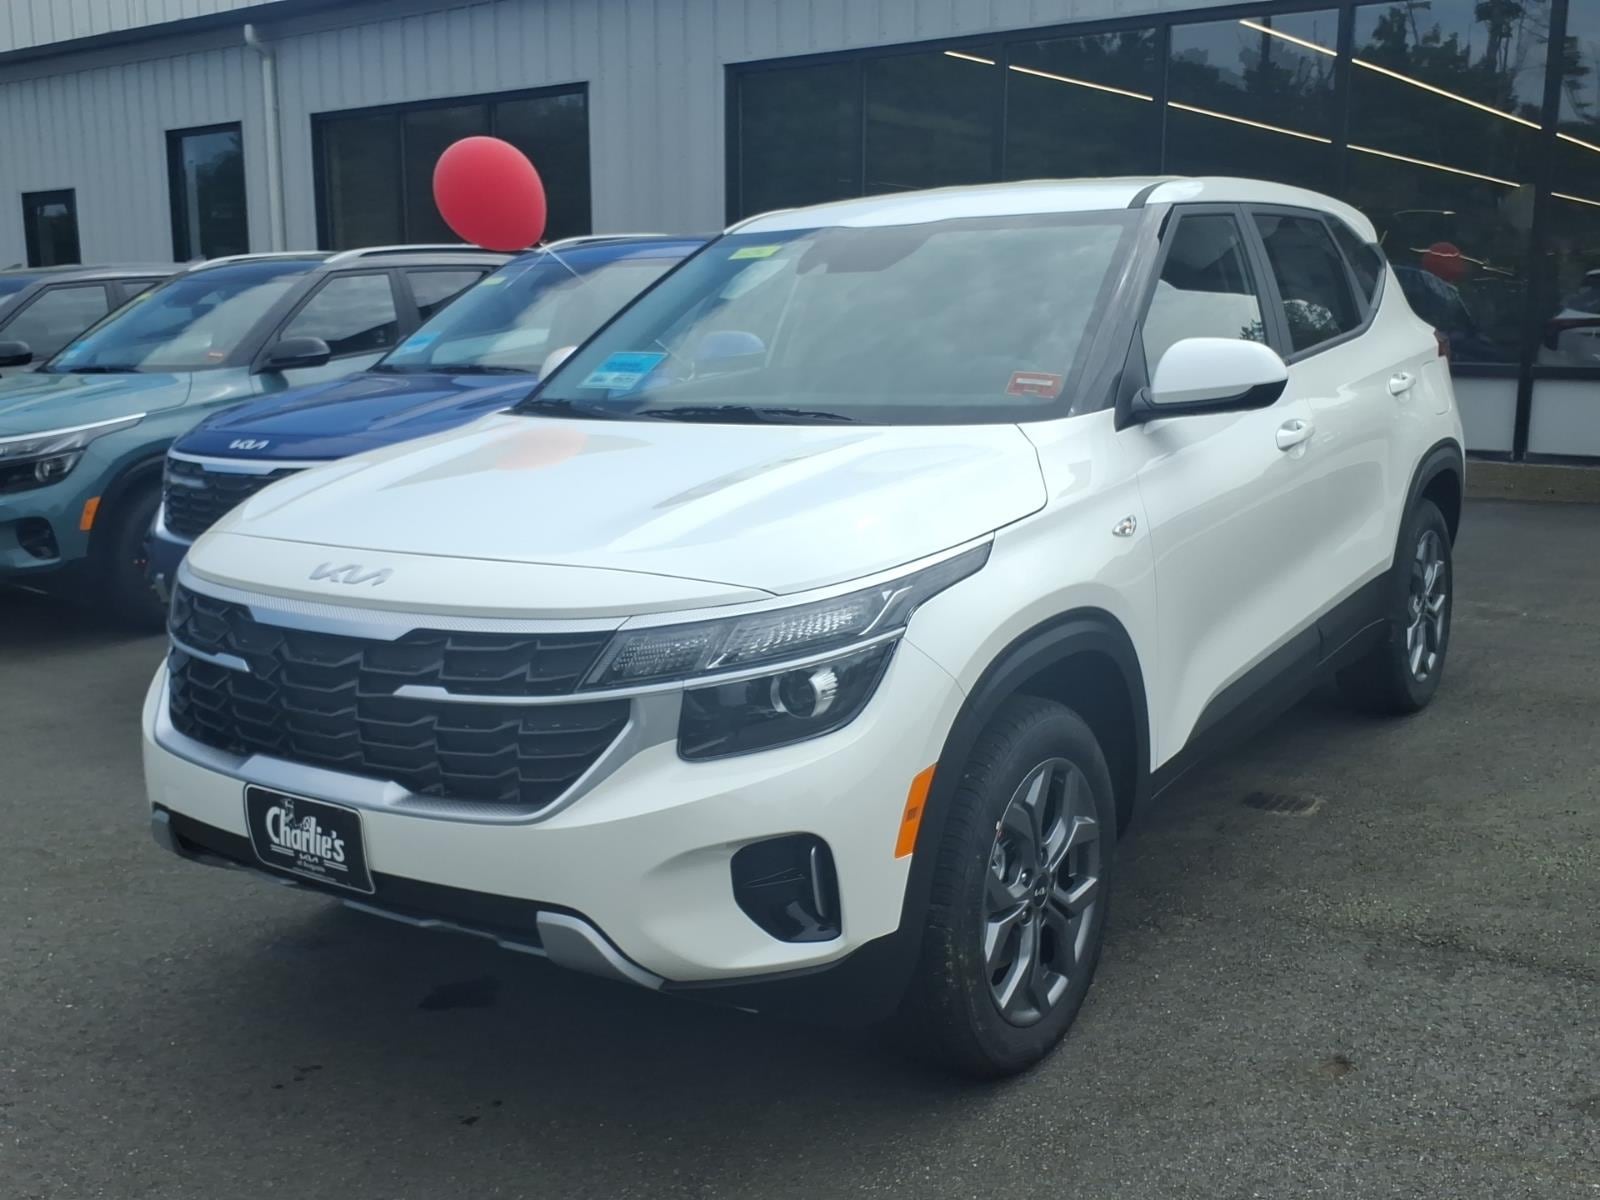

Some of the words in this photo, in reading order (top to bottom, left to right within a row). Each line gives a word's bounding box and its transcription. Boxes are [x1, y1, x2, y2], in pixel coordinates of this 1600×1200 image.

[229, 439, 270, 449] KIA
[309, 562, 394, 586] KIA
[266, 806, 345, 862] Charlie's
